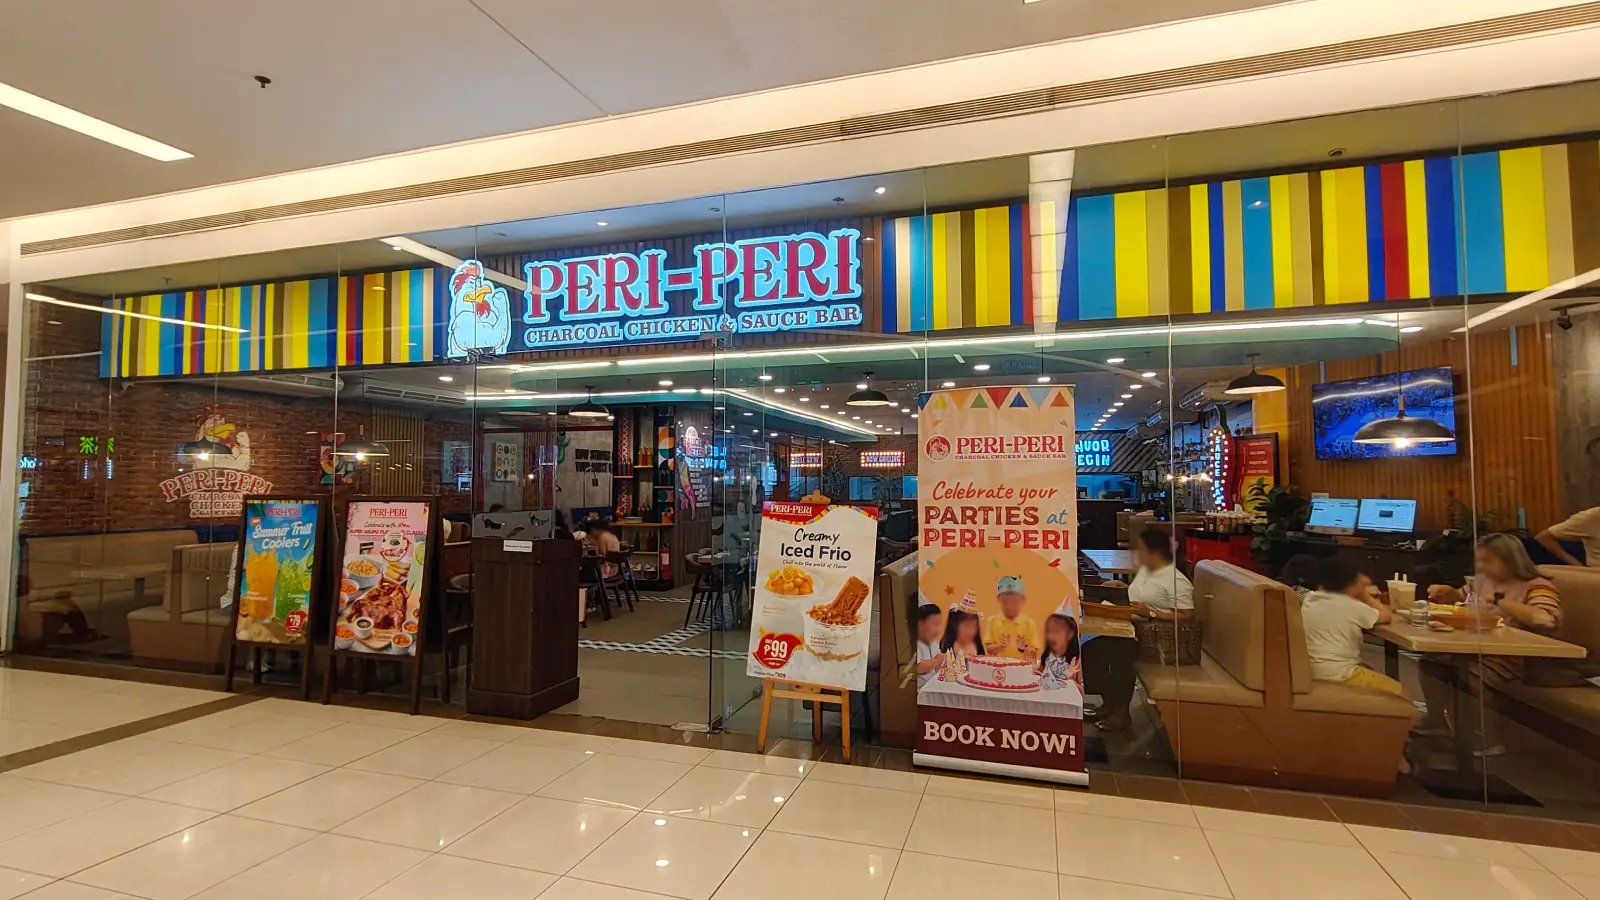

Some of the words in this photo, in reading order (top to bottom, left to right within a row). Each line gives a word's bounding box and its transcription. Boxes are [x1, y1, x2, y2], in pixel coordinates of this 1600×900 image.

[526, 233, 857, 320] PERI-PERI
[526, 325, 621, 344] CHARCOAL
[626, 316, 715, 338] CHICKEN
[719, 315, 735, 332] &
[741, 310, 808, 330] SAUCE
[814, 306, 860, 323] BAR
[956, 435, 1066, 455] PERI-PERI
[1075, 454, 1110, 466] EGIN
[159, 469, 273, 502] PERI-PERI
[932, 480, 1014, 501] Celebrate
[1017, 487, 1058, 506] your
[1214, 480, 1222, 505] BAR
[370, 508, 408, 517] PERI-PERI
[770, 504, 813, 514] PERI-PERI
[924, 505, 1040, 526] PARTIES
[1046, 509, 1069, 526] at
[251, 525, 290, 539] Summer
[291, 521, 313, 536] Fruit
[794, 527, 840, 546] Creamy
[923, 528, 1071, 550] PERI-PERI
[261, 537, 300, 550] Coolers
[780, 542, 815, 559] Iced
[819, 545, 852, 562] Frio
[923, 720, 996, 747] BOOK
[1000, 728, 1076, 756] NOW!
